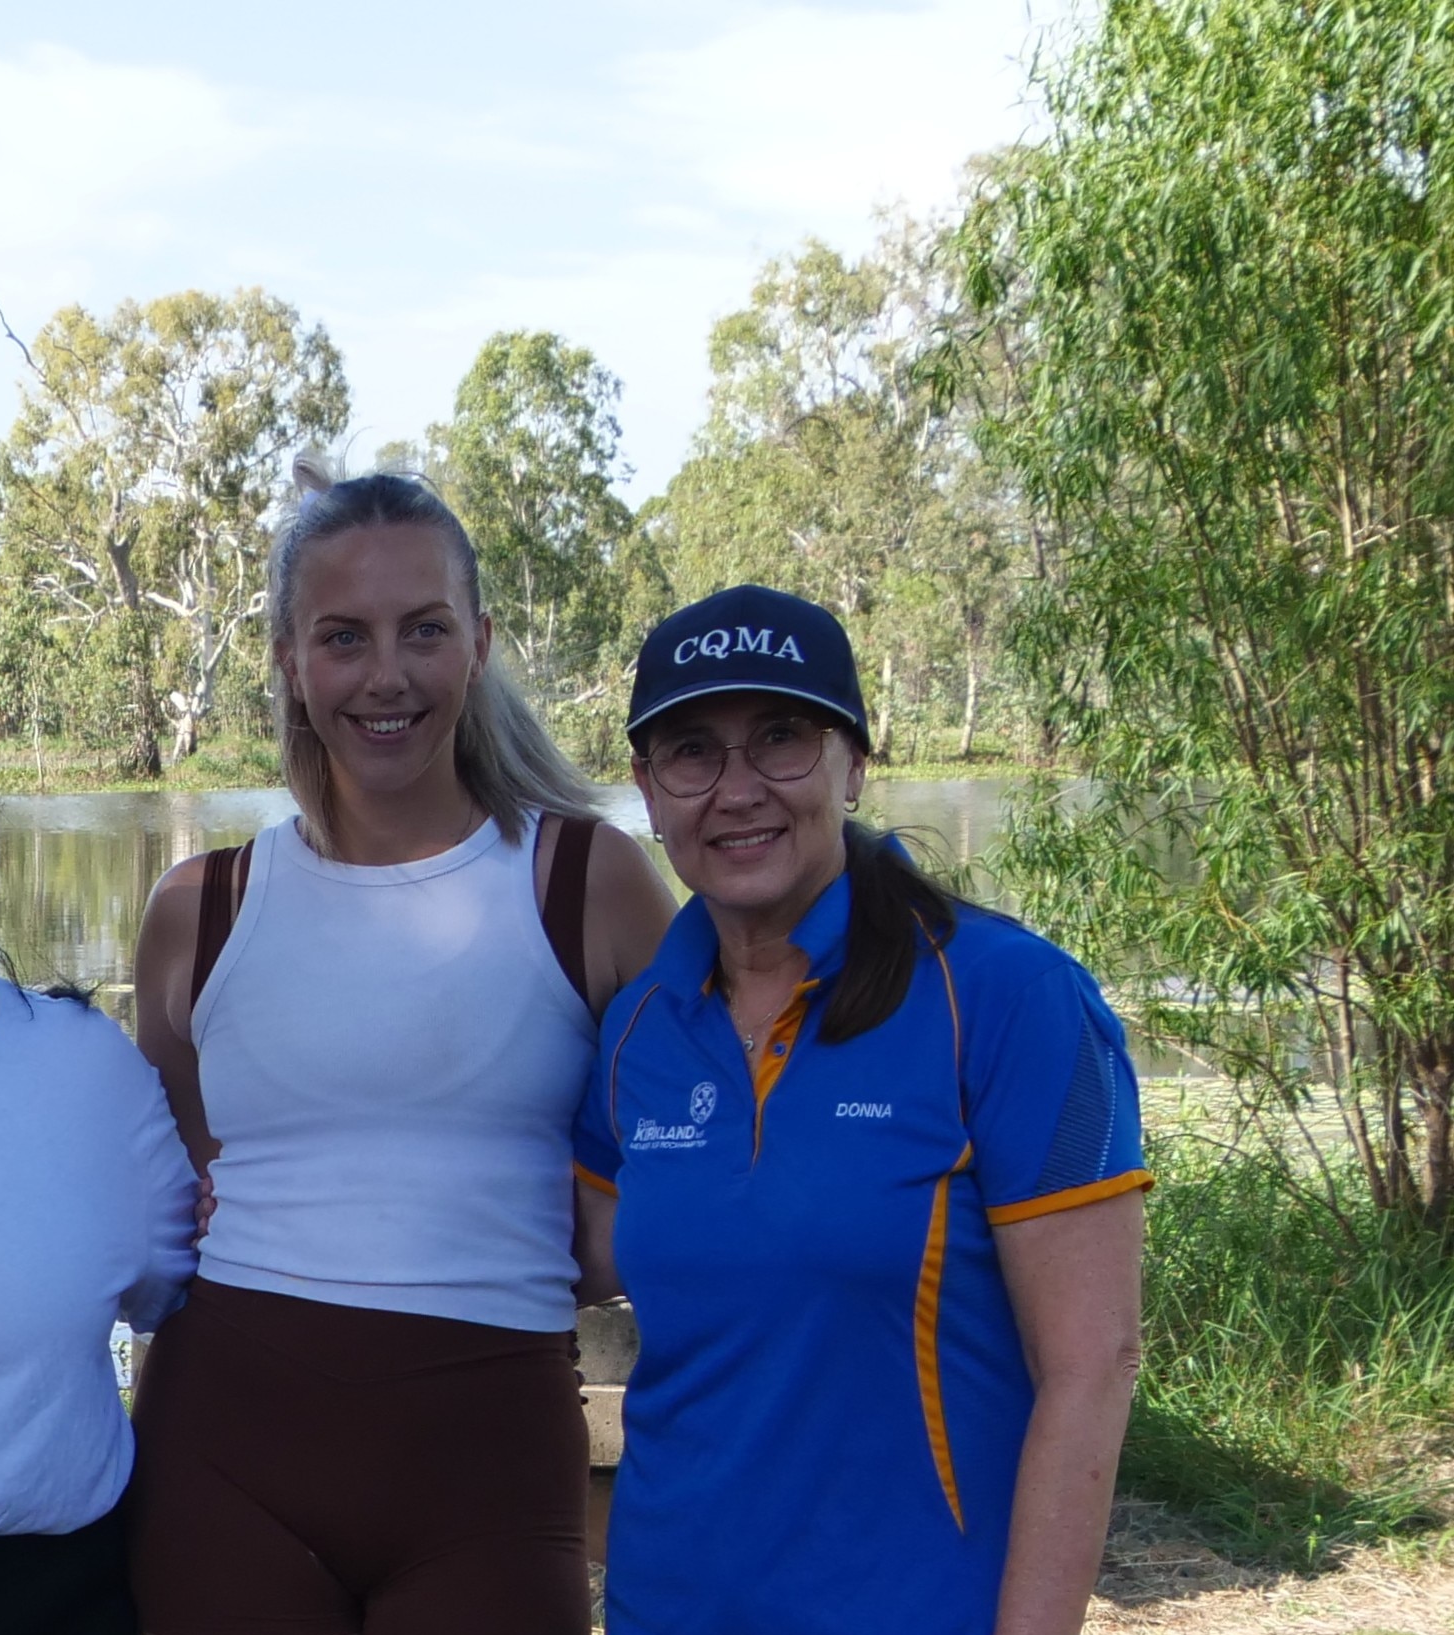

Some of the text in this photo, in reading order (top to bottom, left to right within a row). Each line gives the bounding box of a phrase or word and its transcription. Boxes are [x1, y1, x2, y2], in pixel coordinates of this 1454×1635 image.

[674, 626, 805, 665] CQMA
[835, 1102, 892, 1118] DONNA
[633, 1125, 695, 1141] KIRKLAND
